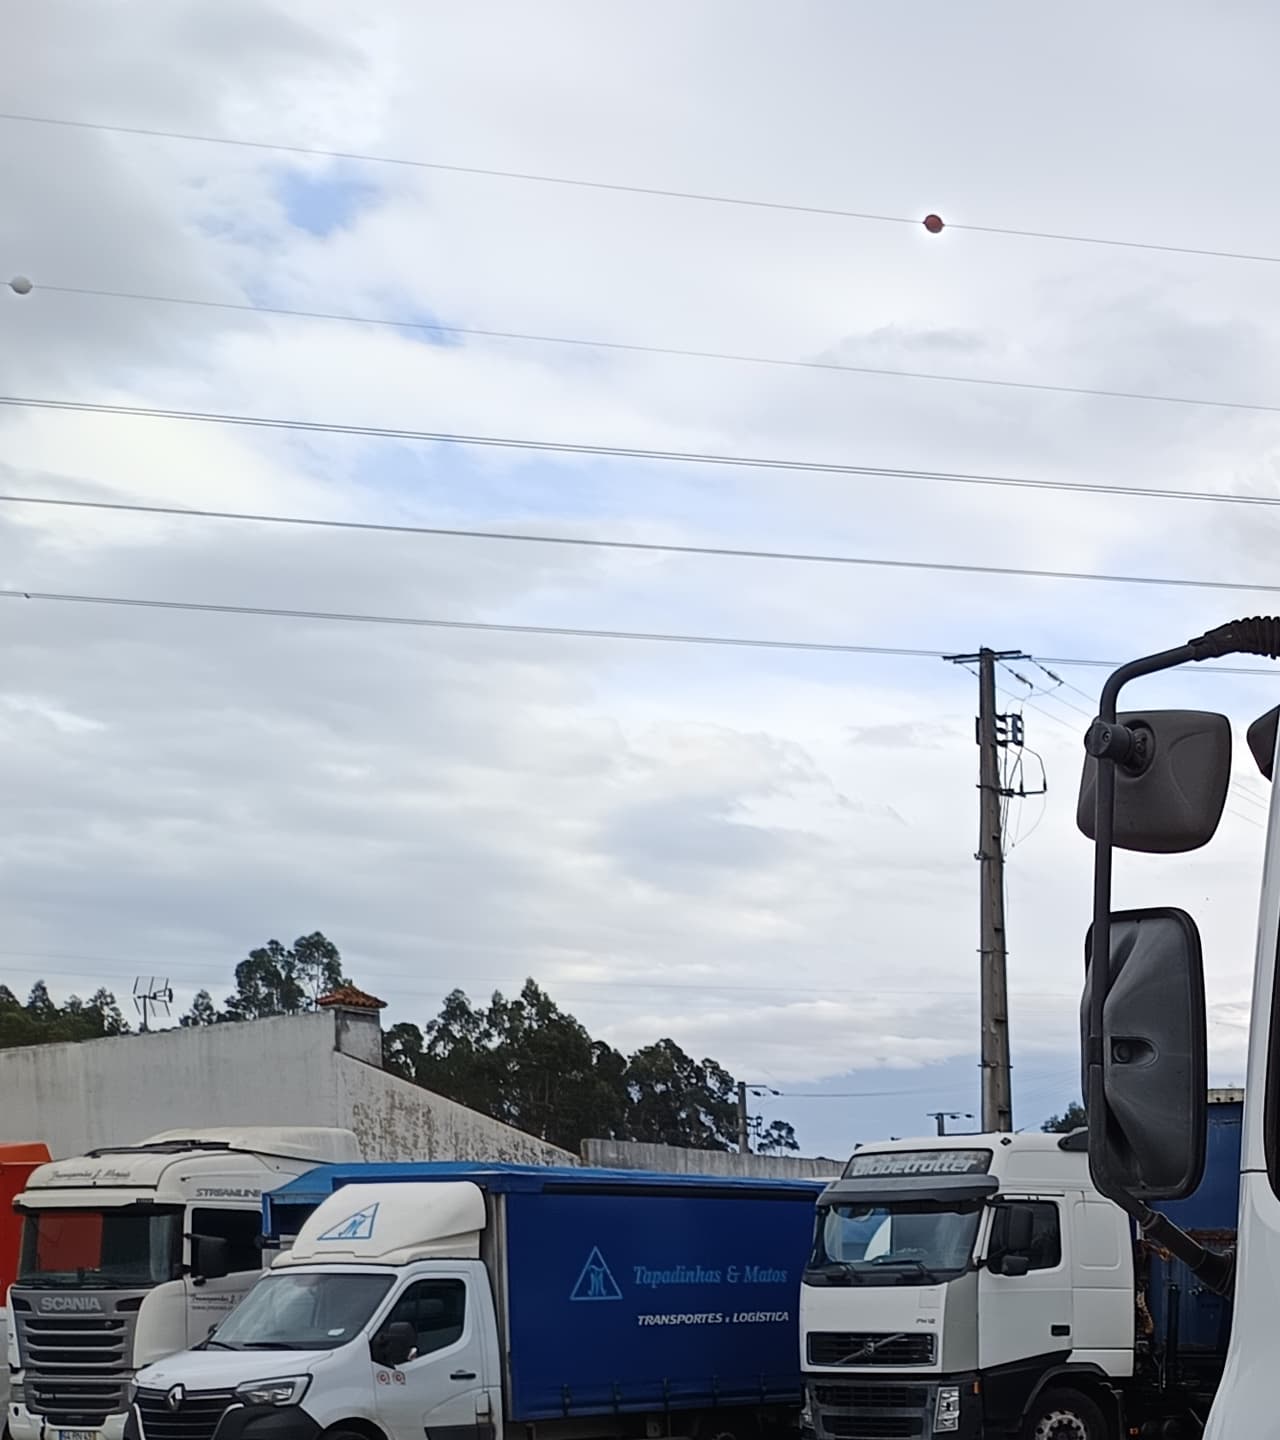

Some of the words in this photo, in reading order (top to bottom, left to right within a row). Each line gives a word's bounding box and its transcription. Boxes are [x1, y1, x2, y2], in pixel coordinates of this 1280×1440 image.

[633, 1264, 721, 1289] Tapadinhas
[726, 1265, 741, 1284] &
[743, 1265, 788, 1284] Matos
[40, 1296, 102, 1311] SCANIA
[637, 1312, 723, 1326] TRANSPORTES
